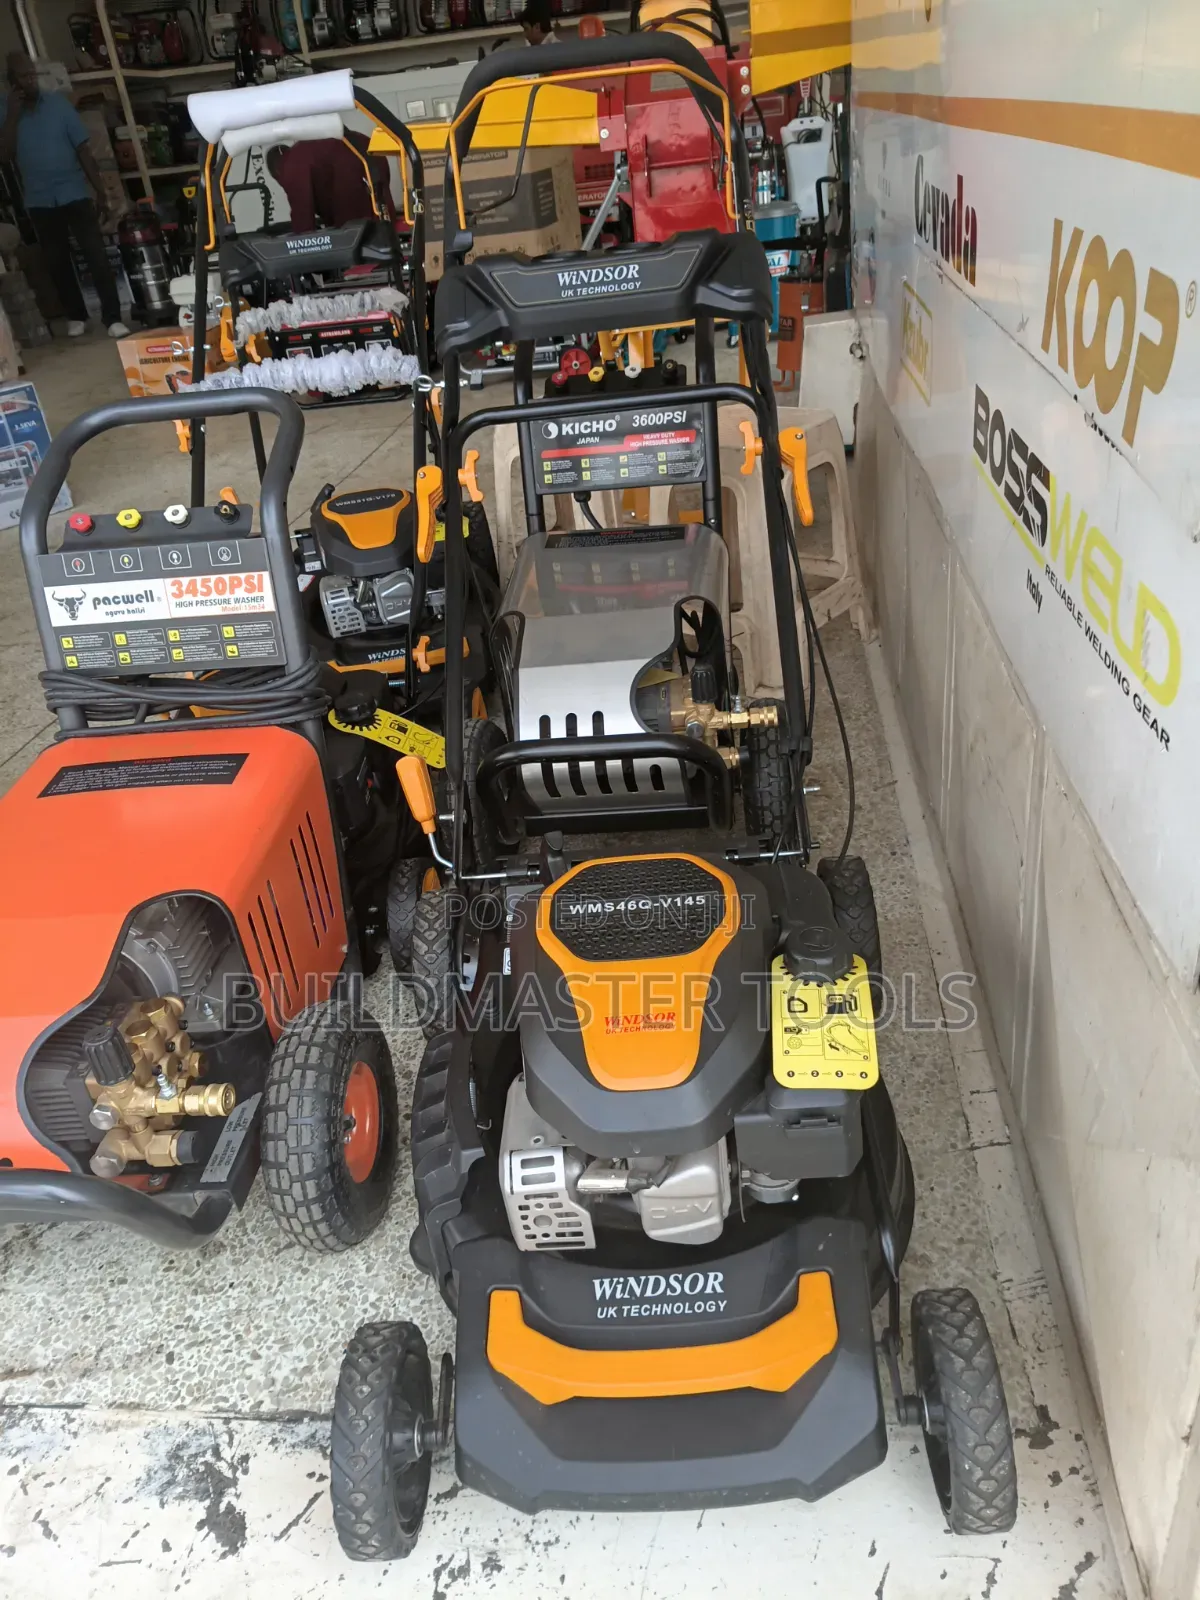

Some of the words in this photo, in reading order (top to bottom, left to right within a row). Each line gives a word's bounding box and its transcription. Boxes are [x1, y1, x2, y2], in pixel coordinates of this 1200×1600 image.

[297, 244, 333, 254] TECHNOLOGY
[561, 289, 574, 298] UK
[577, 281, 642, 296] TECHNOLOGY
[1041, 217, 1180, 449] KOOP
[562, 418, 617, 436] KICHO
[632, 410, 687, 428] 3600PSI
[576, 436, 600, 446] JAPAN
[642, 439, 668, 447] PRESSURE
[669, 437, 690, 445] WASHER
[643, 432, 661, 440] HEAVY
[661, 431, 675, 439] DUTY
[92, 589, 155, 610] pacwell
[170, 573, 264, 599] 3450PSI
[1026, 568, 1043, 614] Italy
[175, 600, 194, 609] HIGH
[195, 598, 232, 607] PRESSURE
[233, 595, 265, 605] WASHER
[1044, 563, 1084, 629] RELIABLE
[1083, 620, 1131, 697] WELDING
[1132, 692, 1171, 752] GEAR
[605, 1027, 616, 1035] UK
[618, 1023, 676, 1033] TECHNOLOGY
[596, 1306, 618, 1319] UK
[622, 1299, 728, 1317] TECHNOLOGY
